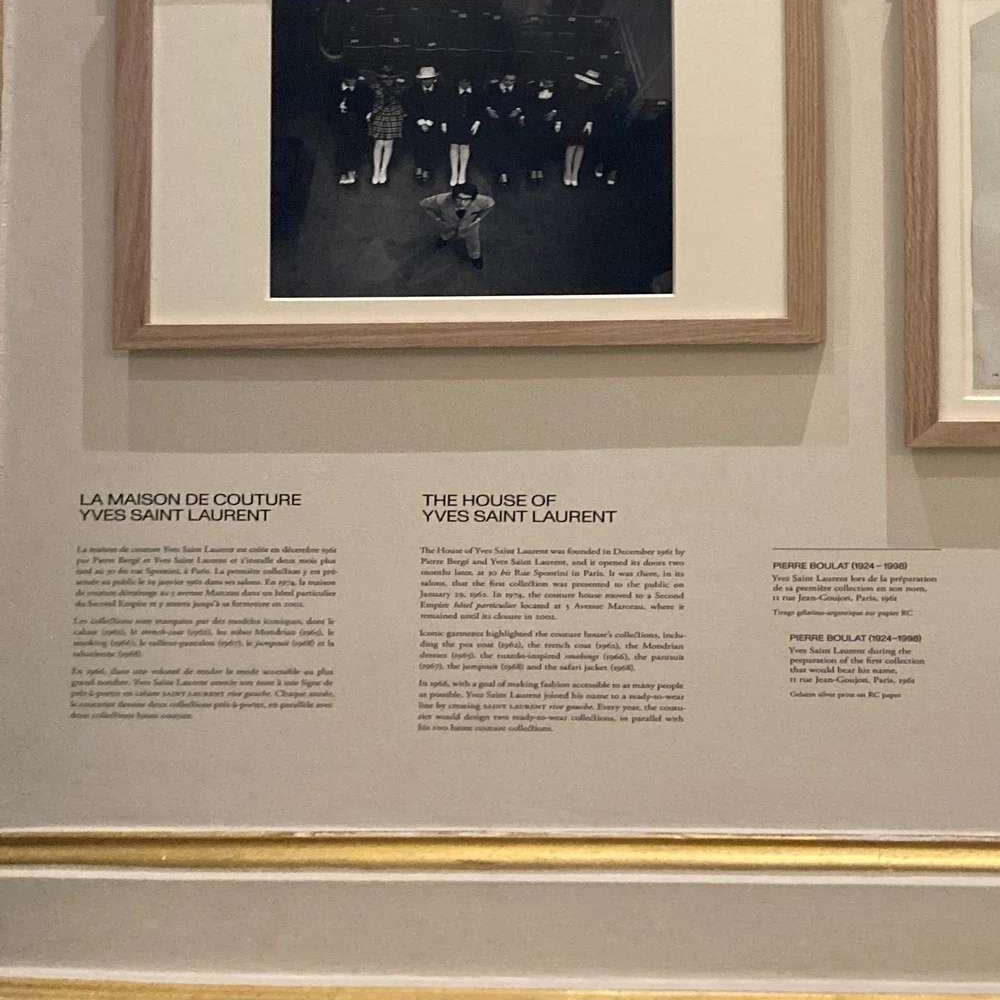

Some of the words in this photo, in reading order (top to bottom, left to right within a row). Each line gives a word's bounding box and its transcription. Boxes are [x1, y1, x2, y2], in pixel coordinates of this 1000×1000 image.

[80, 494, 104, 505] LA
[108, 494, 180, 505] MAISON
[186, 494, 210, 505] DE
[214, 494, 301, 505] COUTURE
[422, 494, 458, 506] THE
[462, 494, 526, 506] HOUSE
[532, 495, 556, 506] OF
[80, 509, 126, 521] YVES
[130, 509, 183, 521] SAINT
[189, 509, 271, 521] LAURENT
[422, 510, 469, 522] YVES
[474, 510, 527, 522] SAINT
[532, 511, 616, 522] LAURENT
[772, 575, 790, 584] Yves
[816, 575, 847, 584] Laurent
[890, 576, 937, 584] préparation
[834, 647, 864, 657] Laurent
[868, 647, 895, 657] during
[899, 648, 911, 657] the
